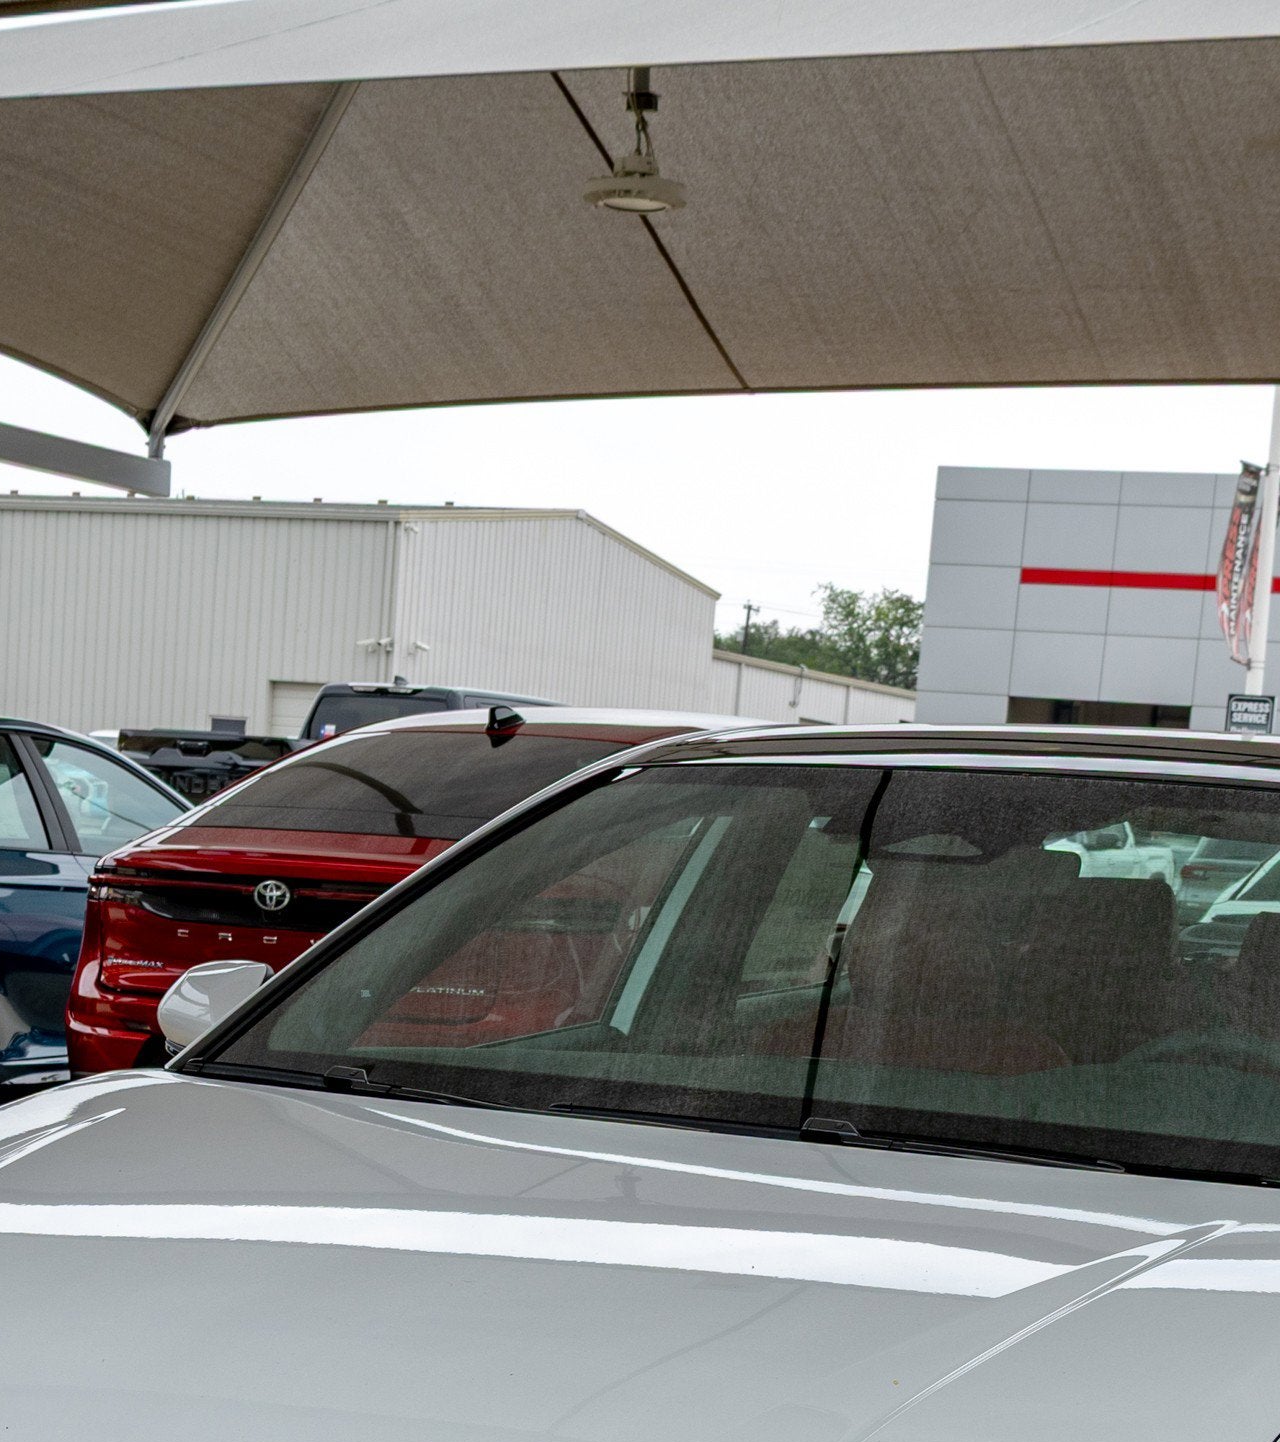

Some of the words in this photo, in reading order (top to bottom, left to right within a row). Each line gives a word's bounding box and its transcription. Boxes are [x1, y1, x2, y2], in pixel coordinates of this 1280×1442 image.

[1229, 513, 1249, 636] MAINTENANCE
[1231, 701, 1270, 713] EXPRESS
[1231, 712, 1268, 724] SERVICE
